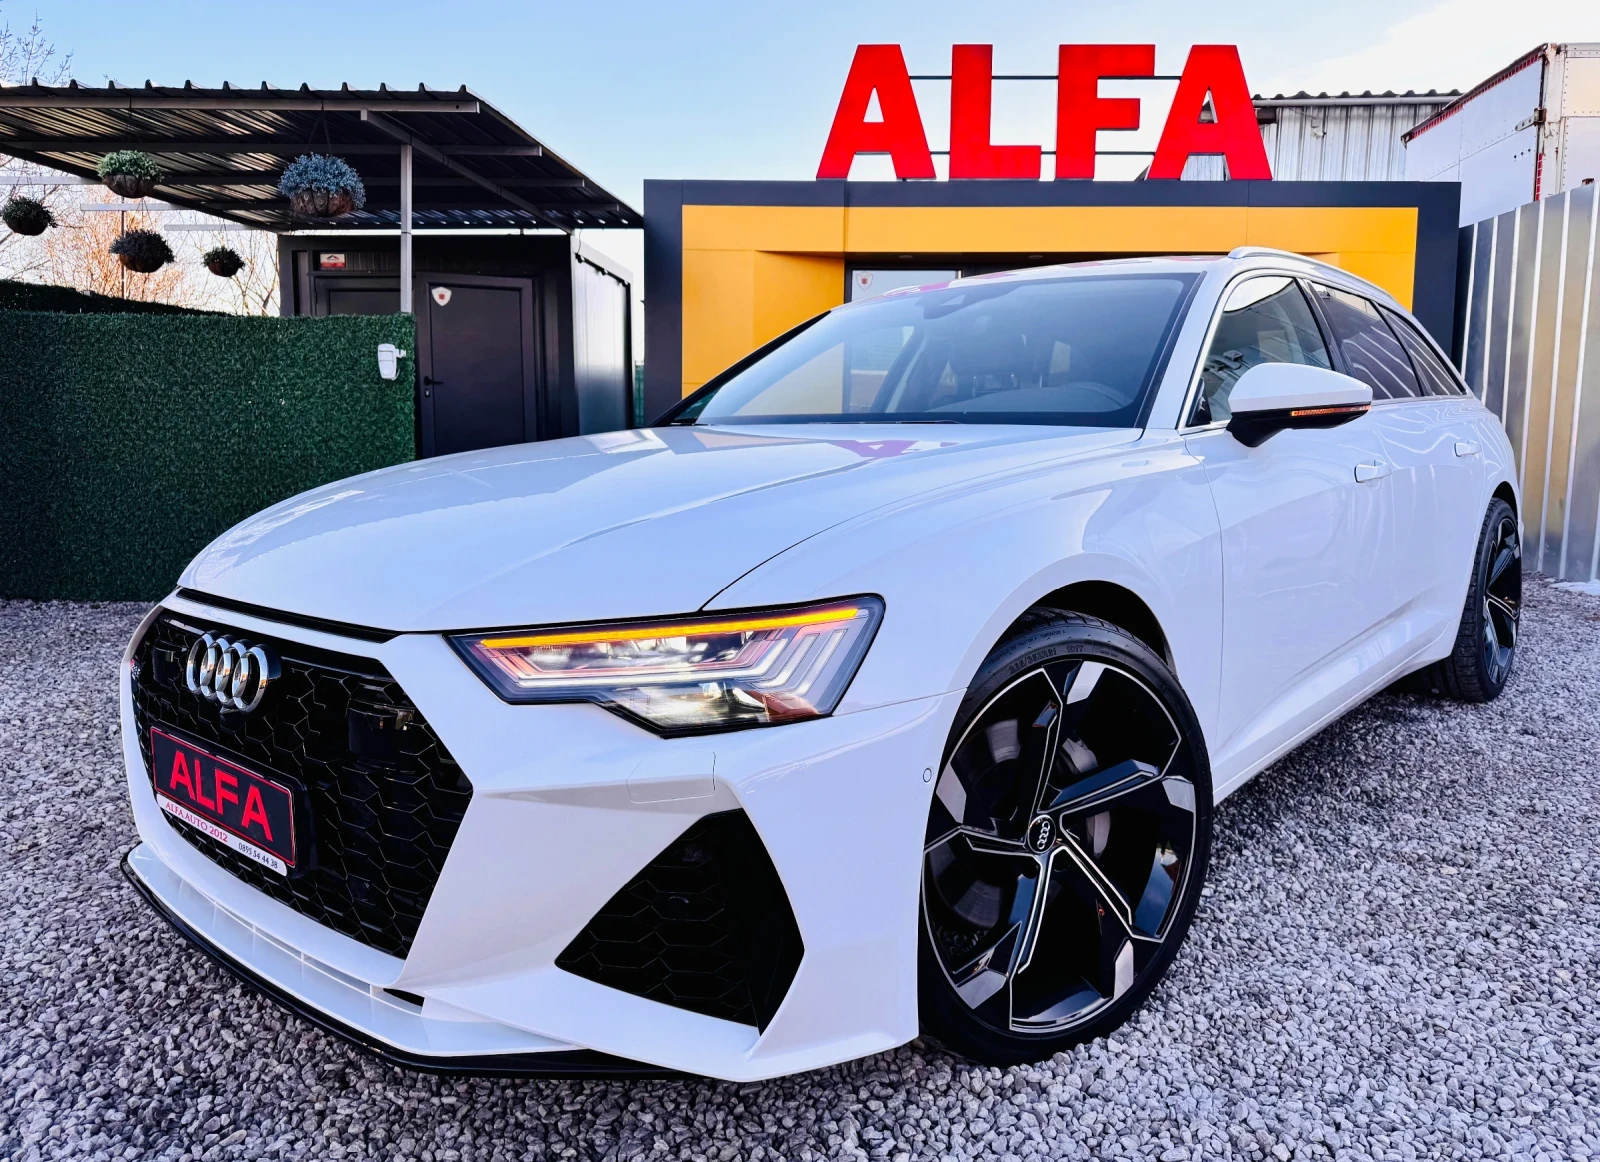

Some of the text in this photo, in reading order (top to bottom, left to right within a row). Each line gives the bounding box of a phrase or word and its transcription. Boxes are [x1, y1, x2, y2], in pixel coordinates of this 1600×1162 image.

[816, 44, 1273, 180] ALFA
[166, 802, 228, 843] ALFA AUTO 2012
[170, 751, 273, 842] ALFA
[253, 850, 260, 860] 54
[262, 855, 269, 864] 44
[270, 859, 278, 869] 38
